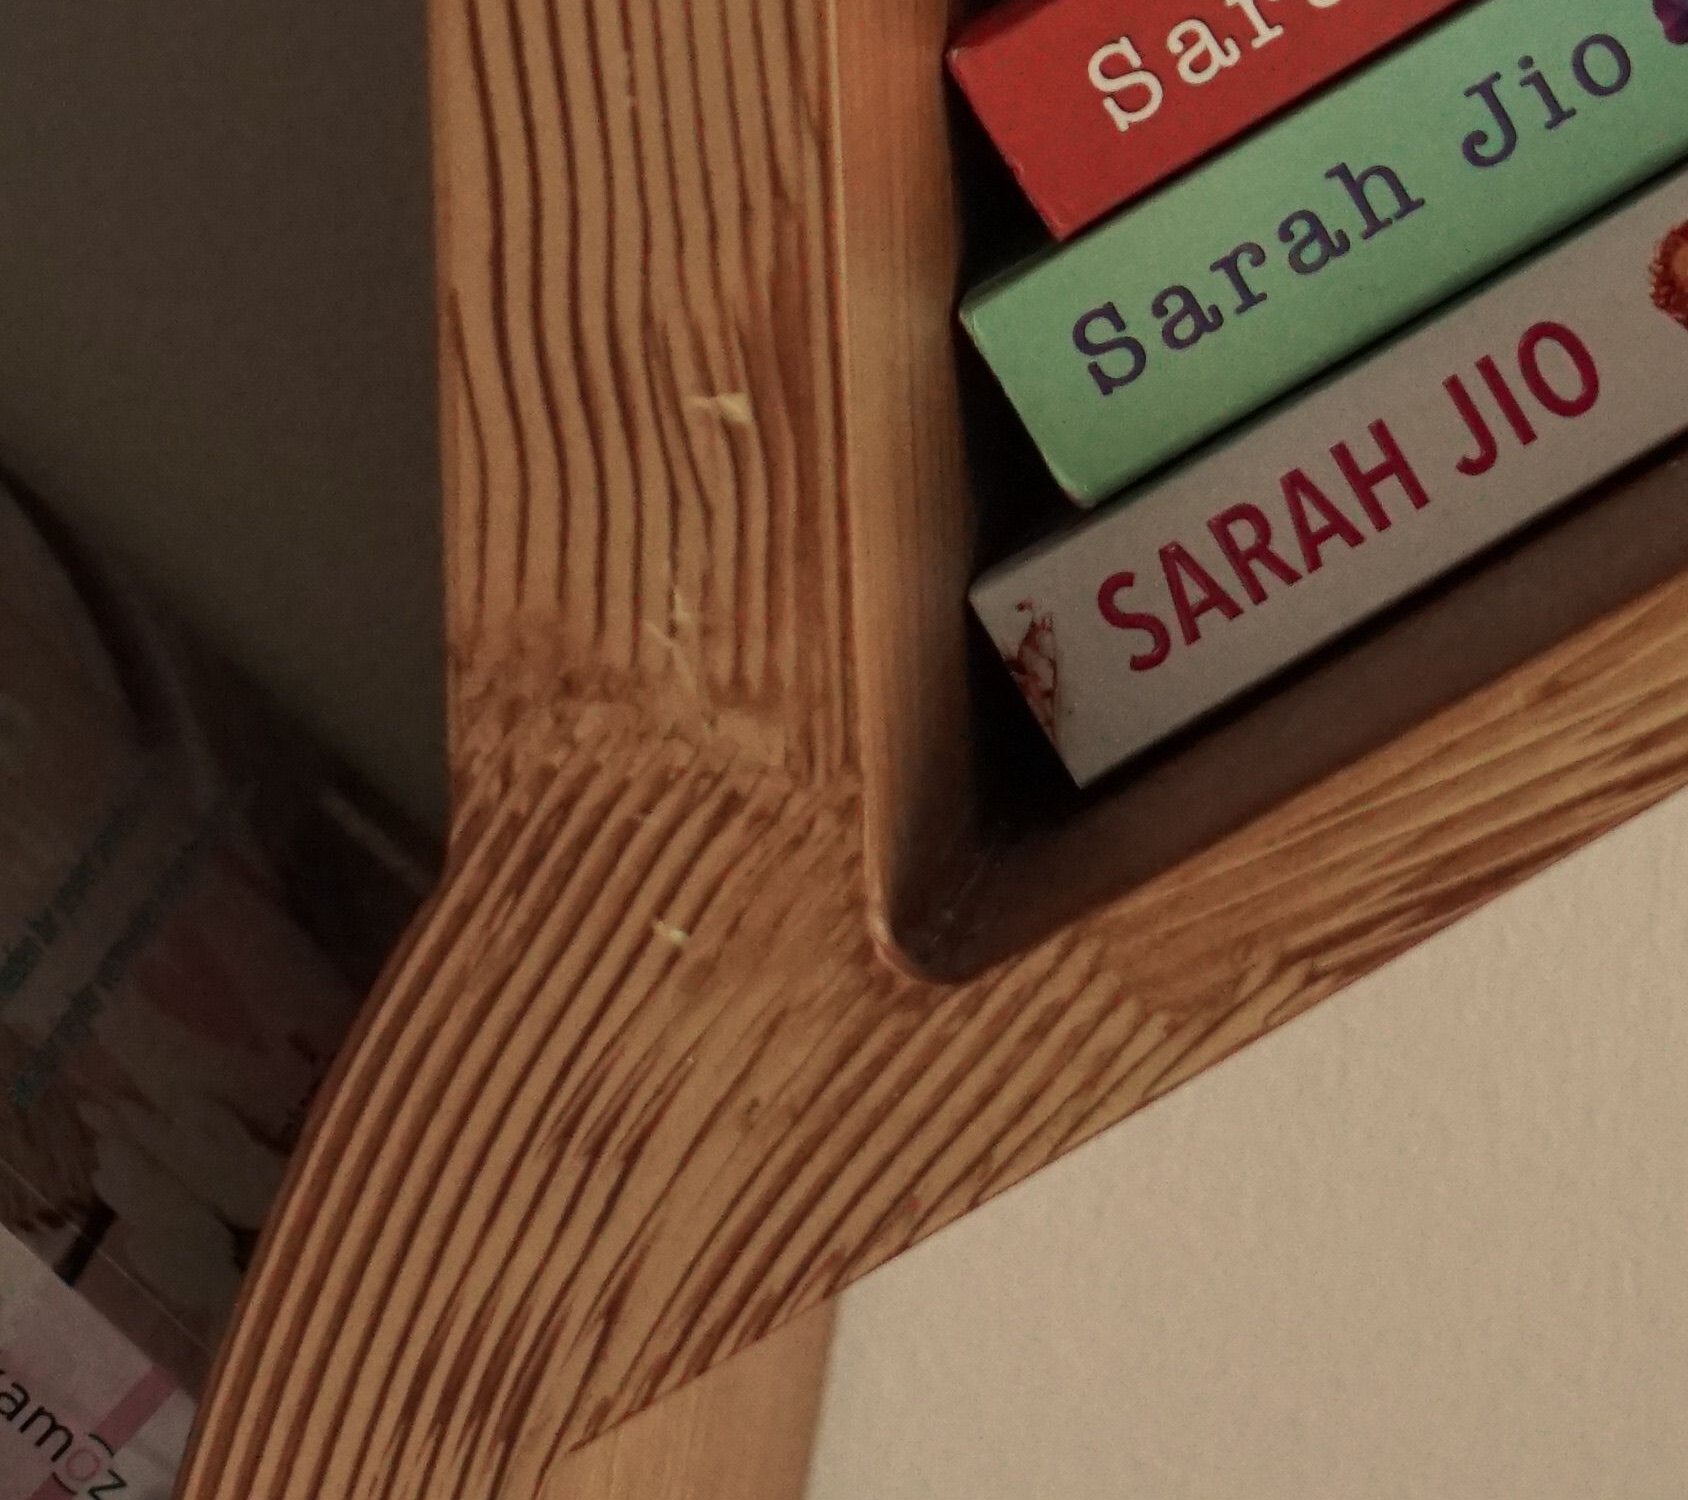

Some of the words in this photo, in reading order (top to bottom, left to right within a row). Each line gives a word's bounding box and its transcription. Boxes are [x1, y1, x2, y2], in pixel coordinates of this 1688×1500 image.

[1070, 160, 1426, 397] Sarah
[1457, 30, 1634, 171] Jio
[1097, 419, 1431, 671] SARAH
[1444, 321, 1602, 476] JIO
